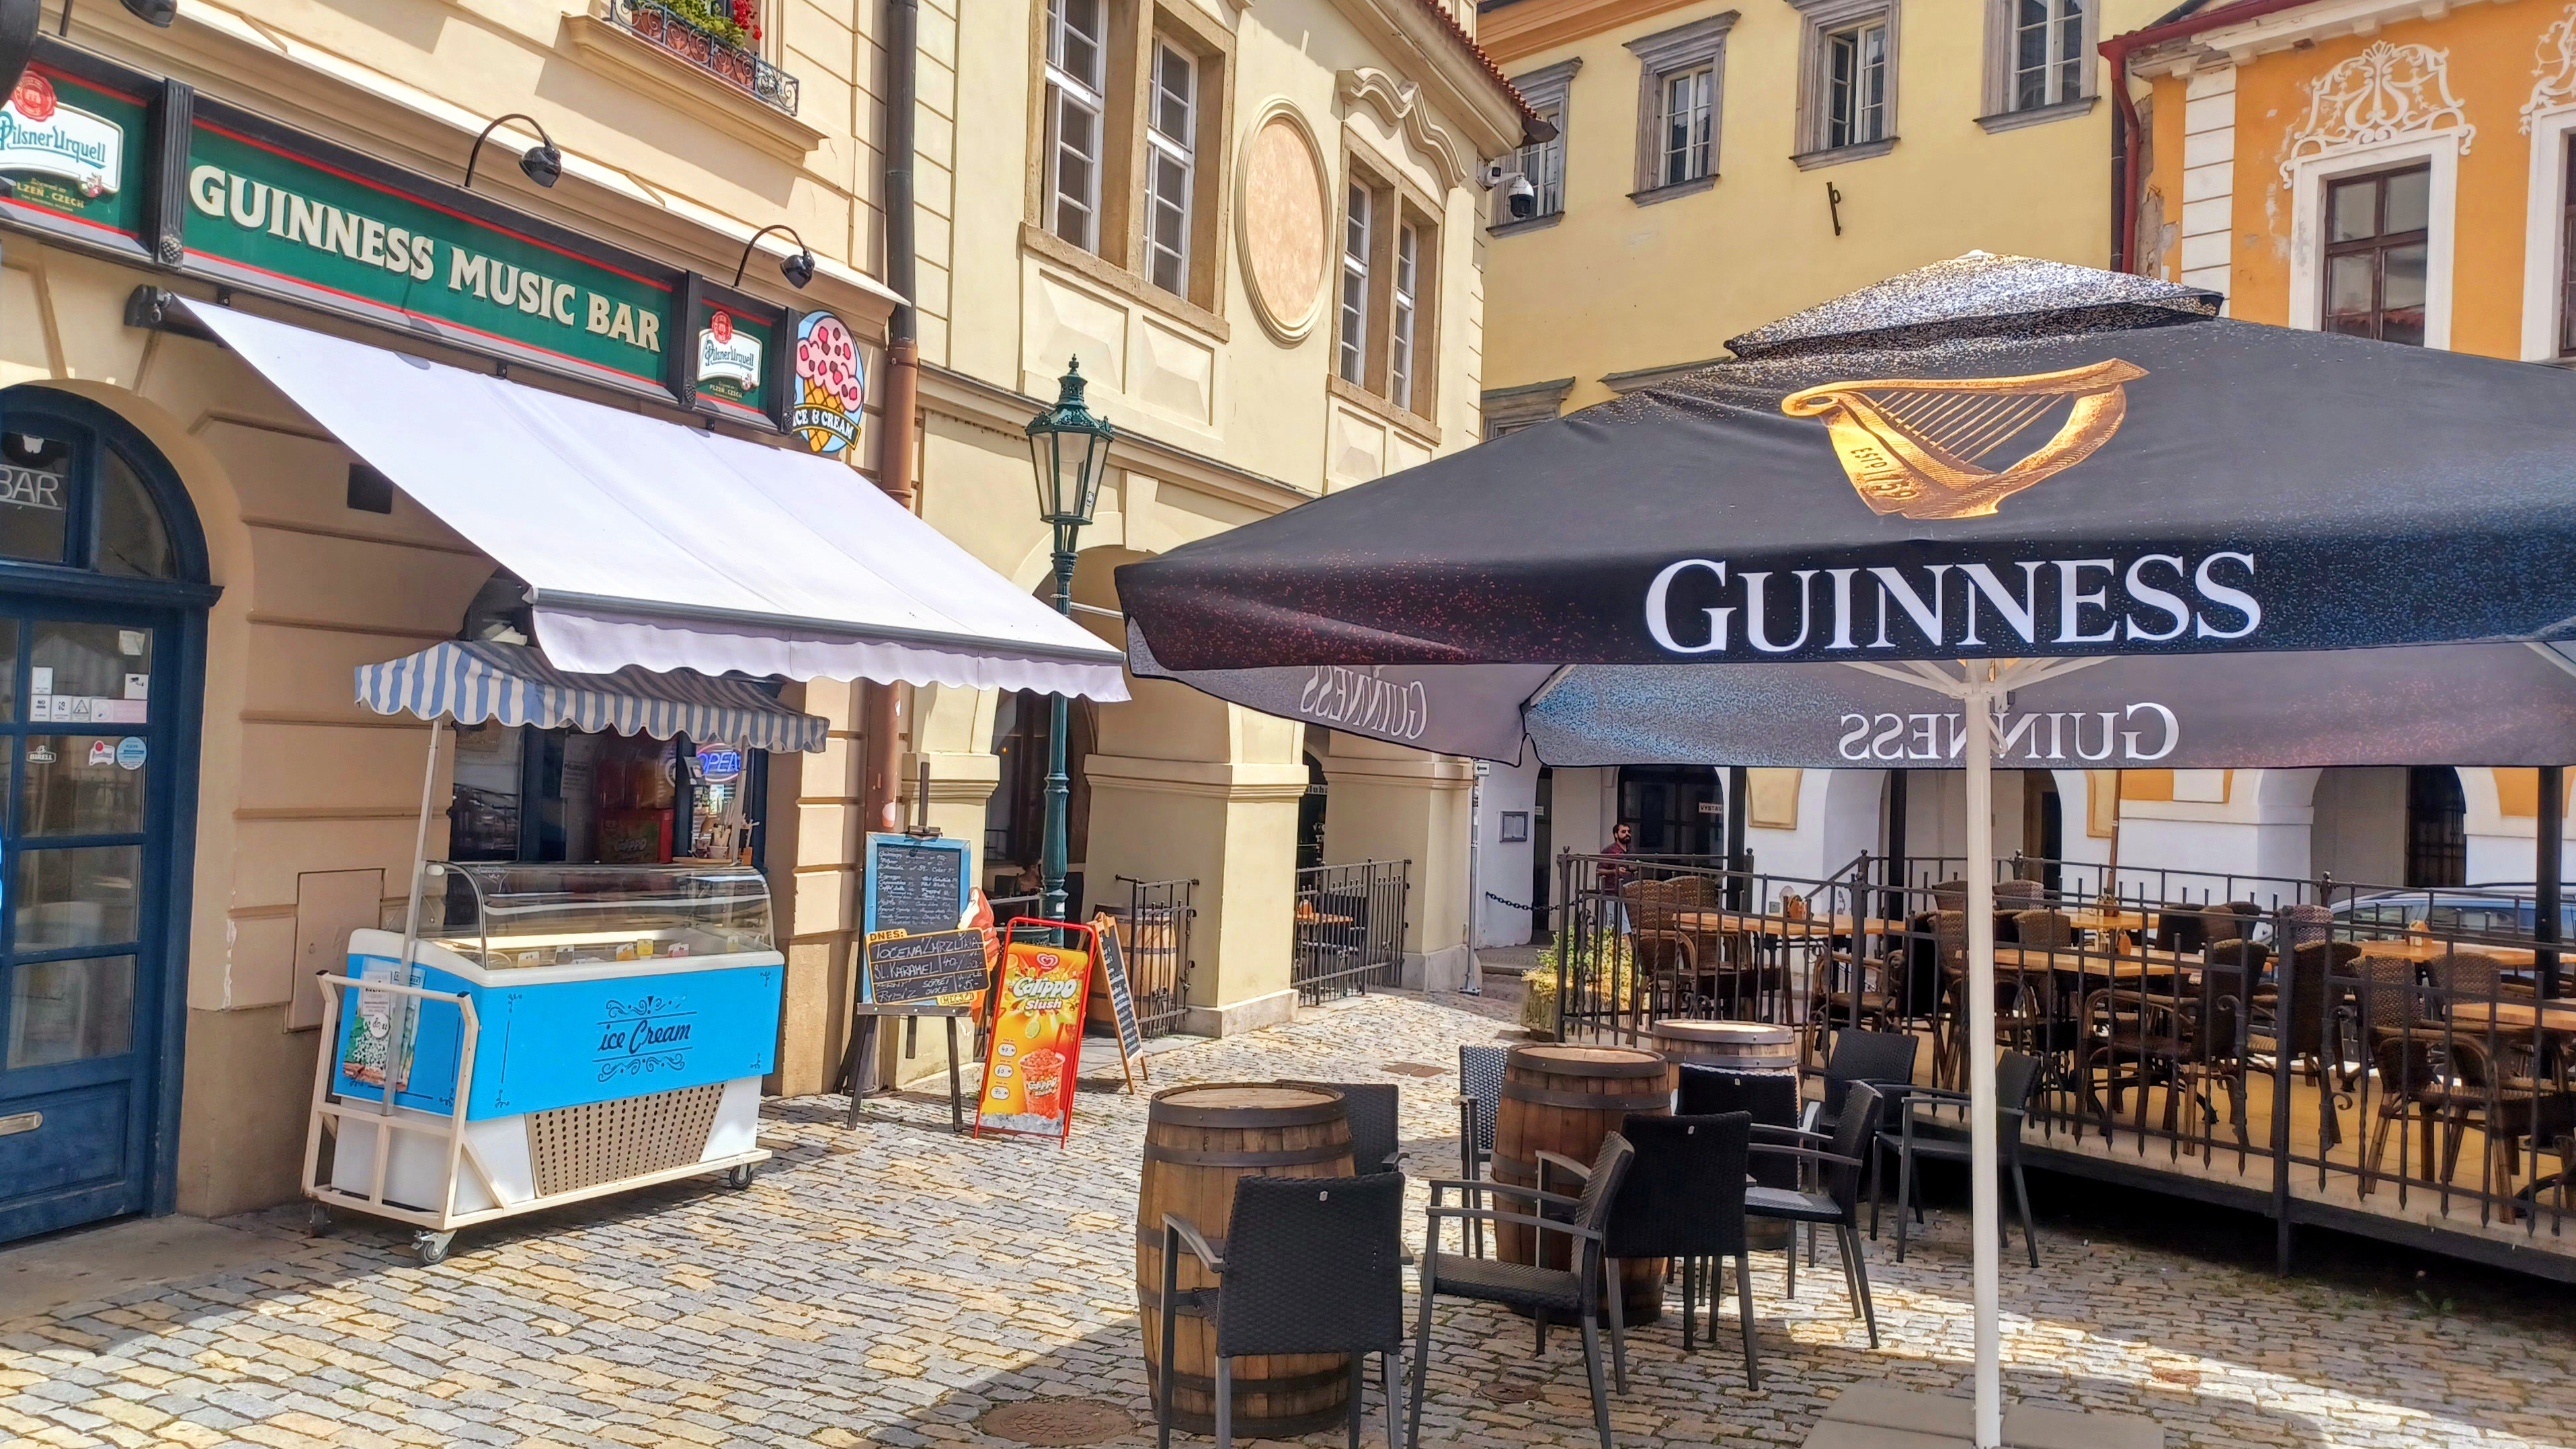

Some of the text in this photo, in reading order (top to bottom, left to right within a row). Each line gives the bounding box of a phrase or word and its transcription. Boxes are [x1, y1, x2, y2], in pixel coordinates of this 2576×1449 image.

[0, 110, 106, 163] Pilsner Urquell
[52, 192, 85, 208] CZECH
[189, 165, 661, 353] GUINNESS MUSIC BAR
[705, 339, 754, 369] Pilsner Urquell
[793, 409, 854, 440] ICE & CREAM
[0, 466, 59, 507] BAR
[1645, 550, 2262, 655] GUINNESS
[869, 930, 904, 941] DNES:
[1012, 977, 1078, 998] Calippo
[1024, 999, 1063, 1010] slush
[597, 1020, 691, 1054] ice Cream
